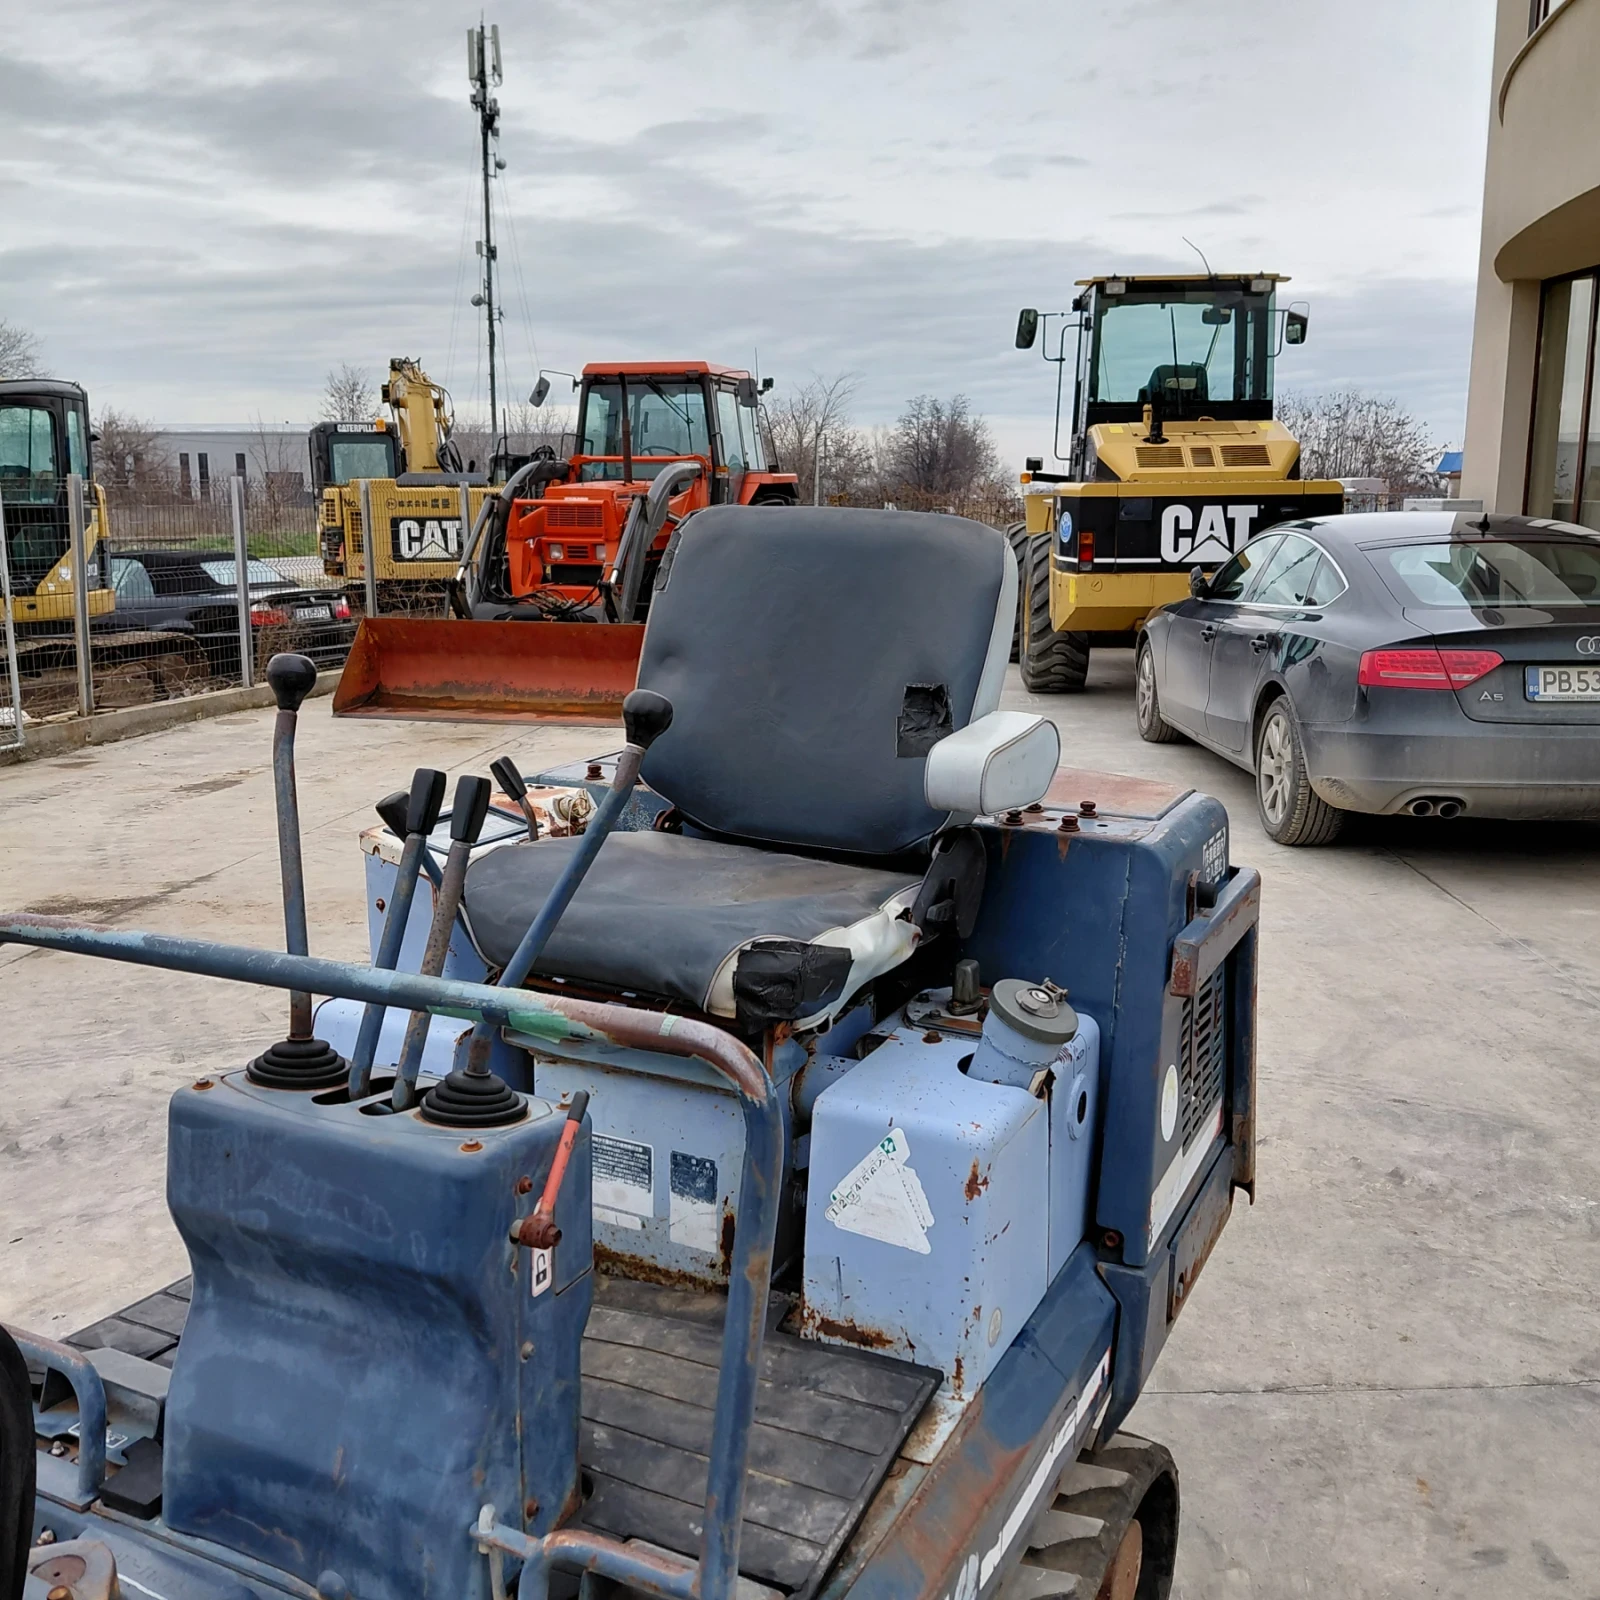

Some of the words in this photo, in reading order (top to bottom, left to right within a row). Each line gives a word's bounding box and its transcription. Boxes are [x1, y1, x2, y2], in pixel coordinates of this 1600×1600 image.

[337, 424, 377, 432] CATERPILLA
[1161, 504, 1258, 562] CAT
[400, 520, 461, 558] CAT
[1529, 685, 1538, 693] BG
[1480, 691, 1504, 701] A5
